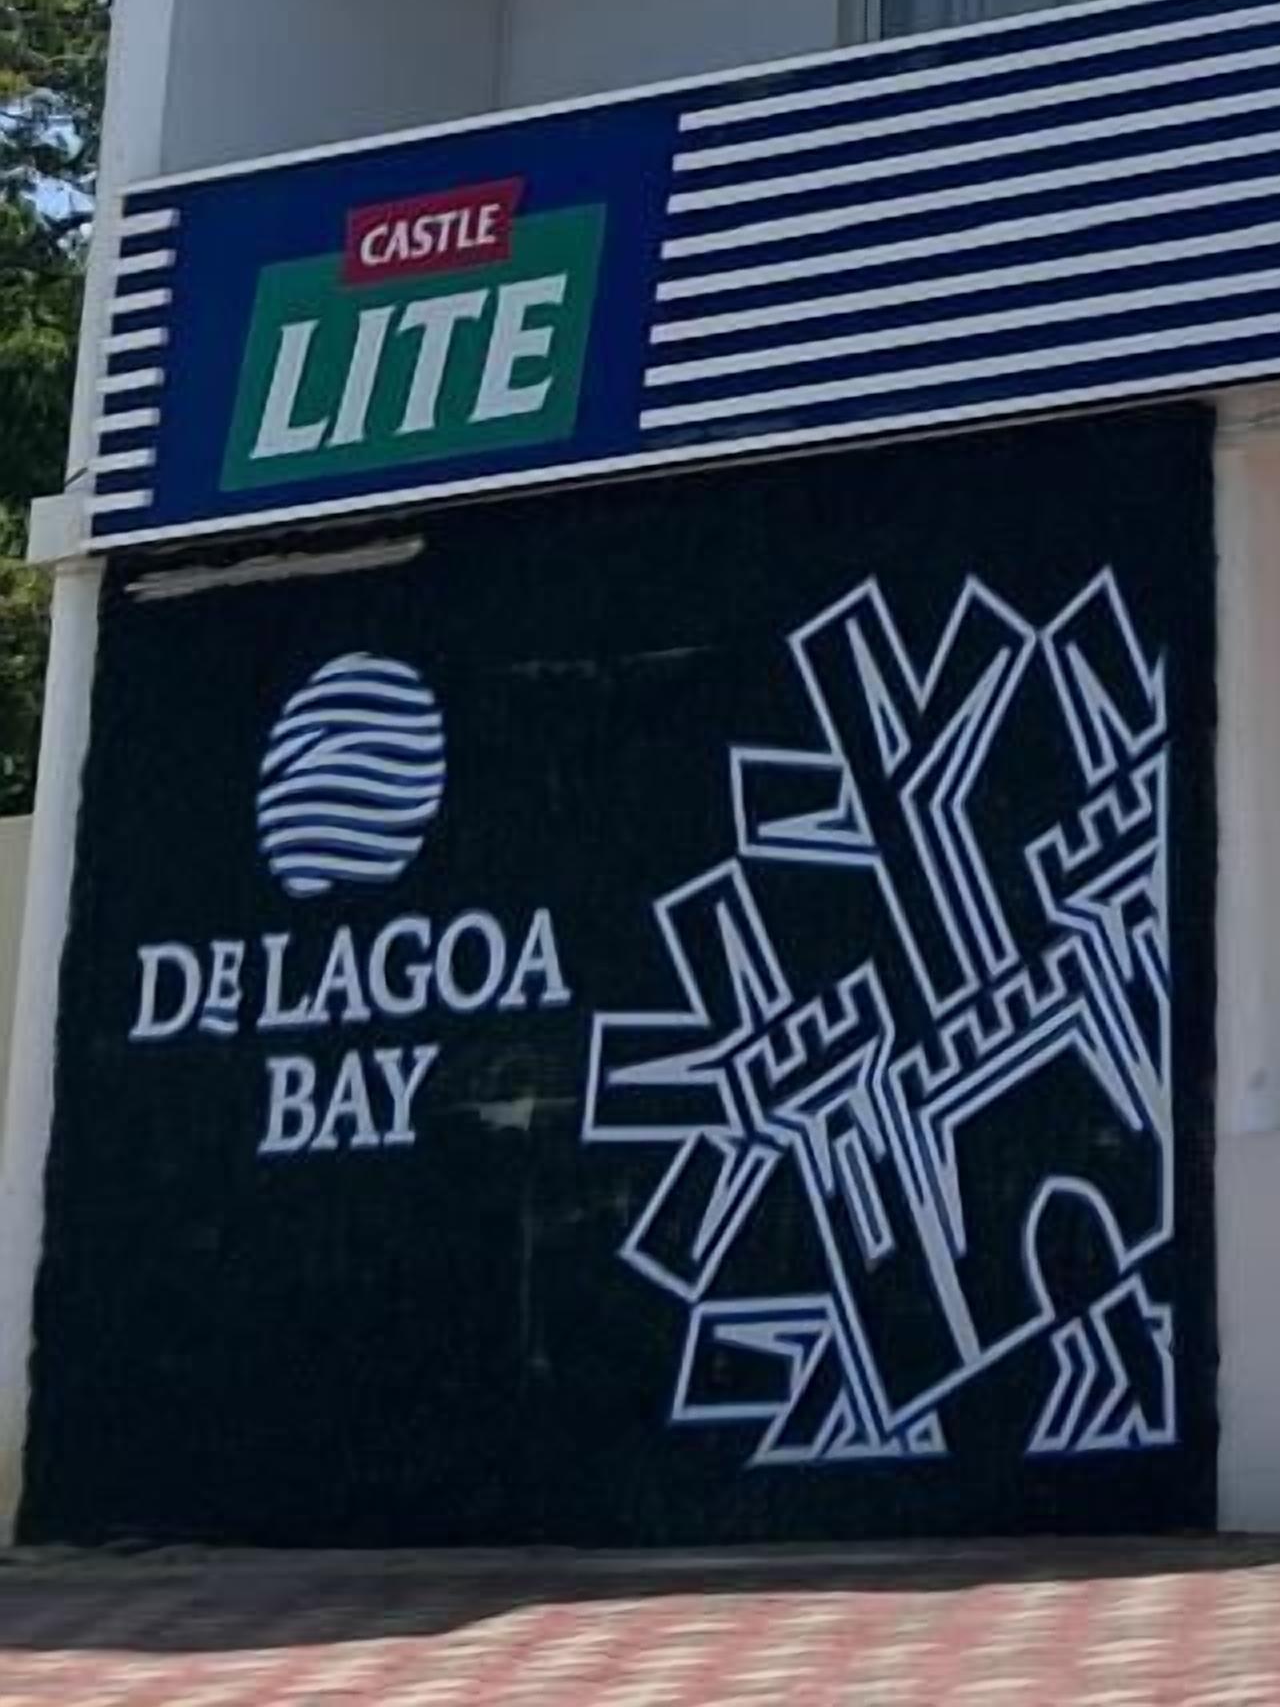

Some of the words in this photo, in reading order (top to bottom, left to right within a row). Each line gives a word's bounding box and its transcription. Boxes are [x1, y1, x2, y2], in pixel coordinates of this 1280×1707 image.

[360, 203, 501, 266] CASTLE
[249, 272, 568, 460] LITE
[255, 1043, 440, 1155] BAY
